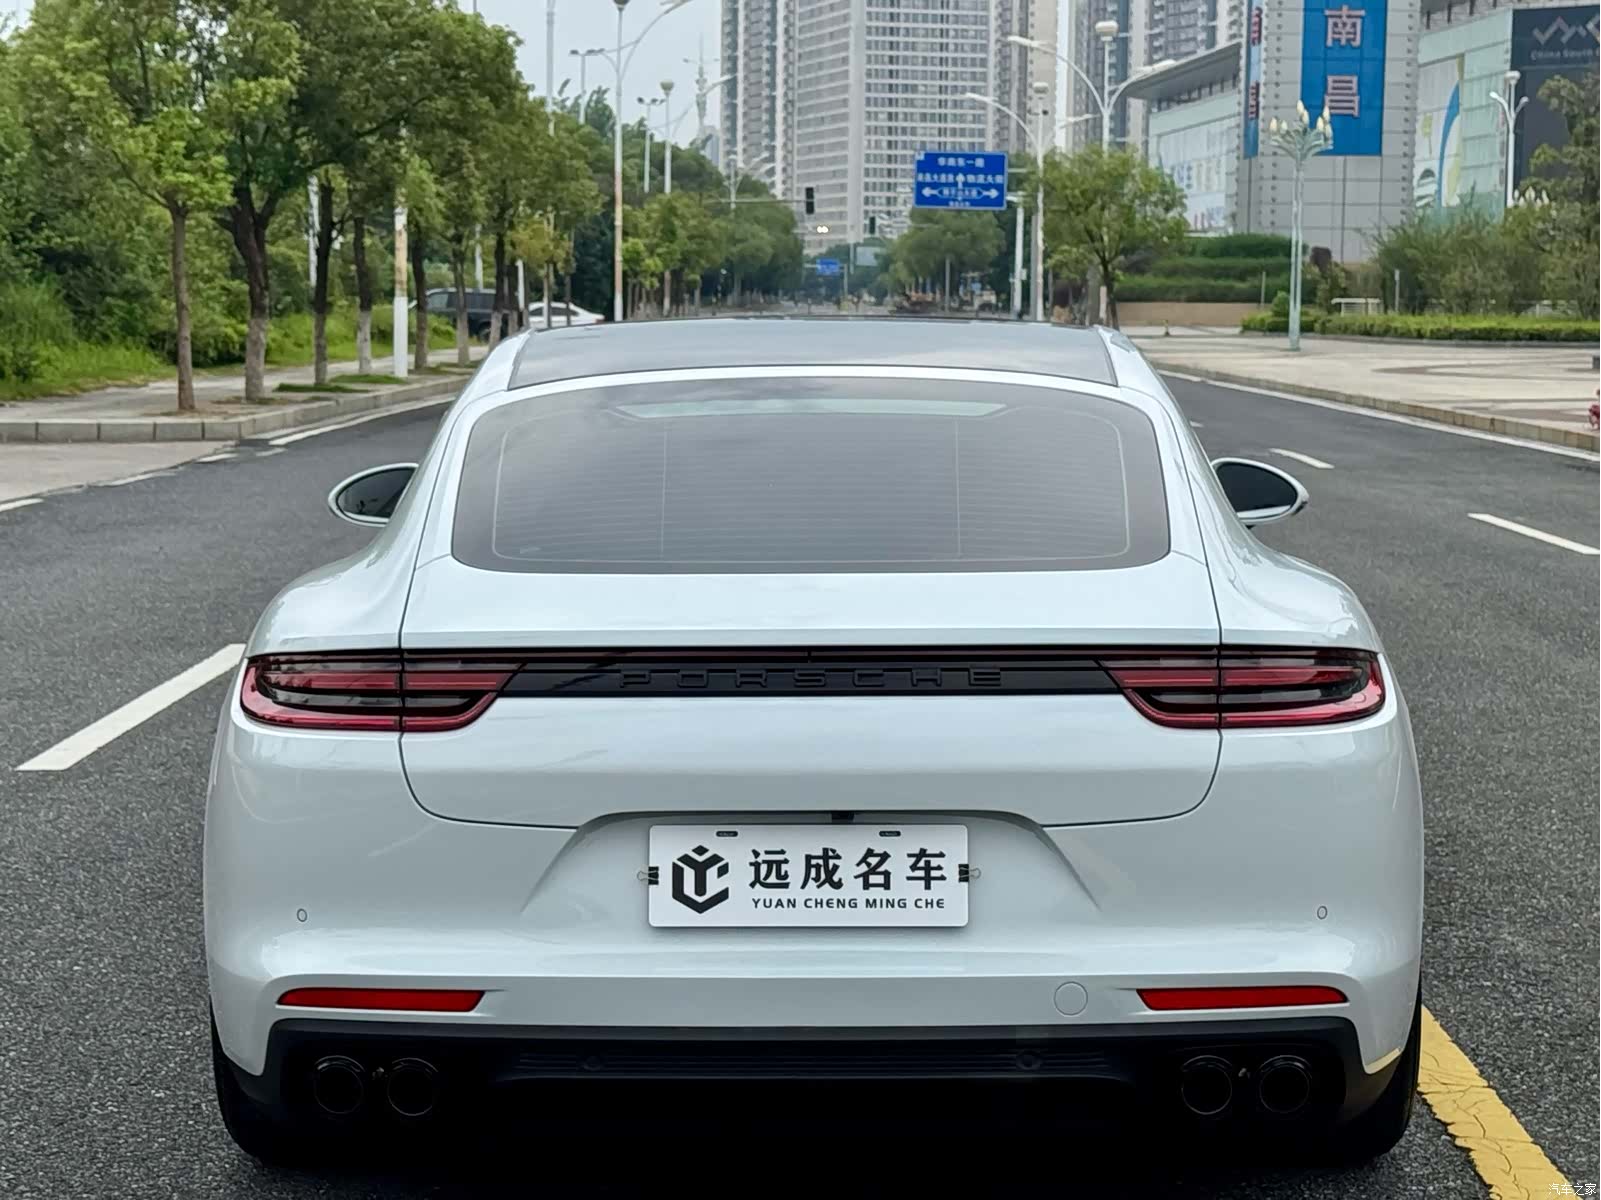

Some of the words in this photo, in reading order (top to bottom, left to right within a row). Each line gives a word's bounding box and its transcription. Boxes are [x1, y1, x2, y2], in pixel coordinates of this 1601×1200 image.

[1324, 5, 1366, 118] 南昌
[619, 668, 1002, 688] PORSCHE
[748, 847, 948, 891] 远成名车
[751, 897, 797, 909] YUAN
[803, 897, 858, 909] CHENG
[865, 897, 908, 909] MING
[914, 897, 945, 909] CHE
